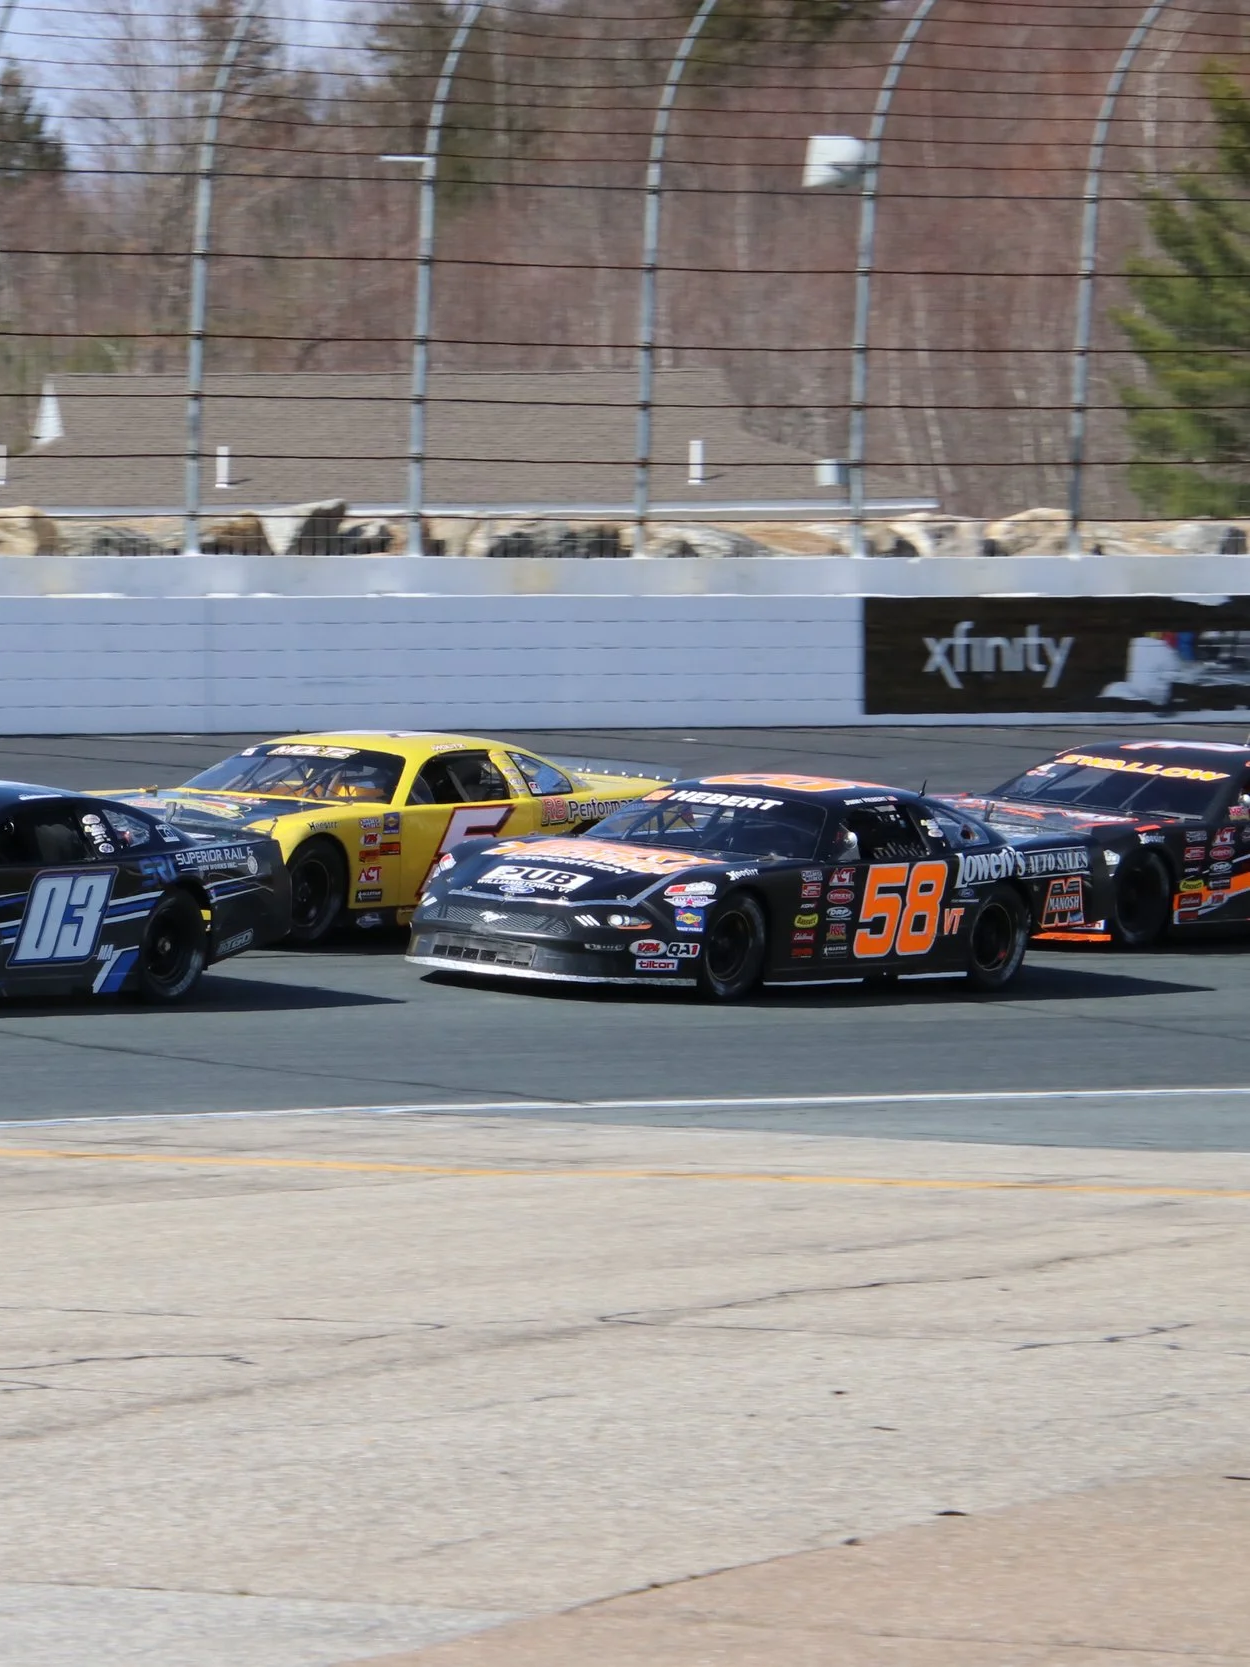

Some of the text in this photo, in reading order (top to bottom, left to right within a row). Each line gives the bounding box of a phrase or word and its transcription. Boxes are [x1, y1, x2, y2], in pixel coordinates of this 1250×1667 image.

[921, 620, 1075, 689] xfinity
[1054, 754, 1231, 782] SWALLOW
[541, 797, 568, 826] RB
[668, 790, 784, 811] HEBERT
[175, 848, 221, 867] SUPERIOR
[224, 847, 247, 861] RAIL
[1029, 853, 1054, 874] AUTO
[1056, 850, 1089, 871] SALES
[558, 886, 574, 895] VT
[853, 860, 948, 958] 58
[1048, 895, 1080, 912] MANOSH
[14, 874, 111, 960] 03
[943, 907, 965, 935] VT
[668, 943, 699, 956] QA1
[639, 960, 675, 969] tilton
